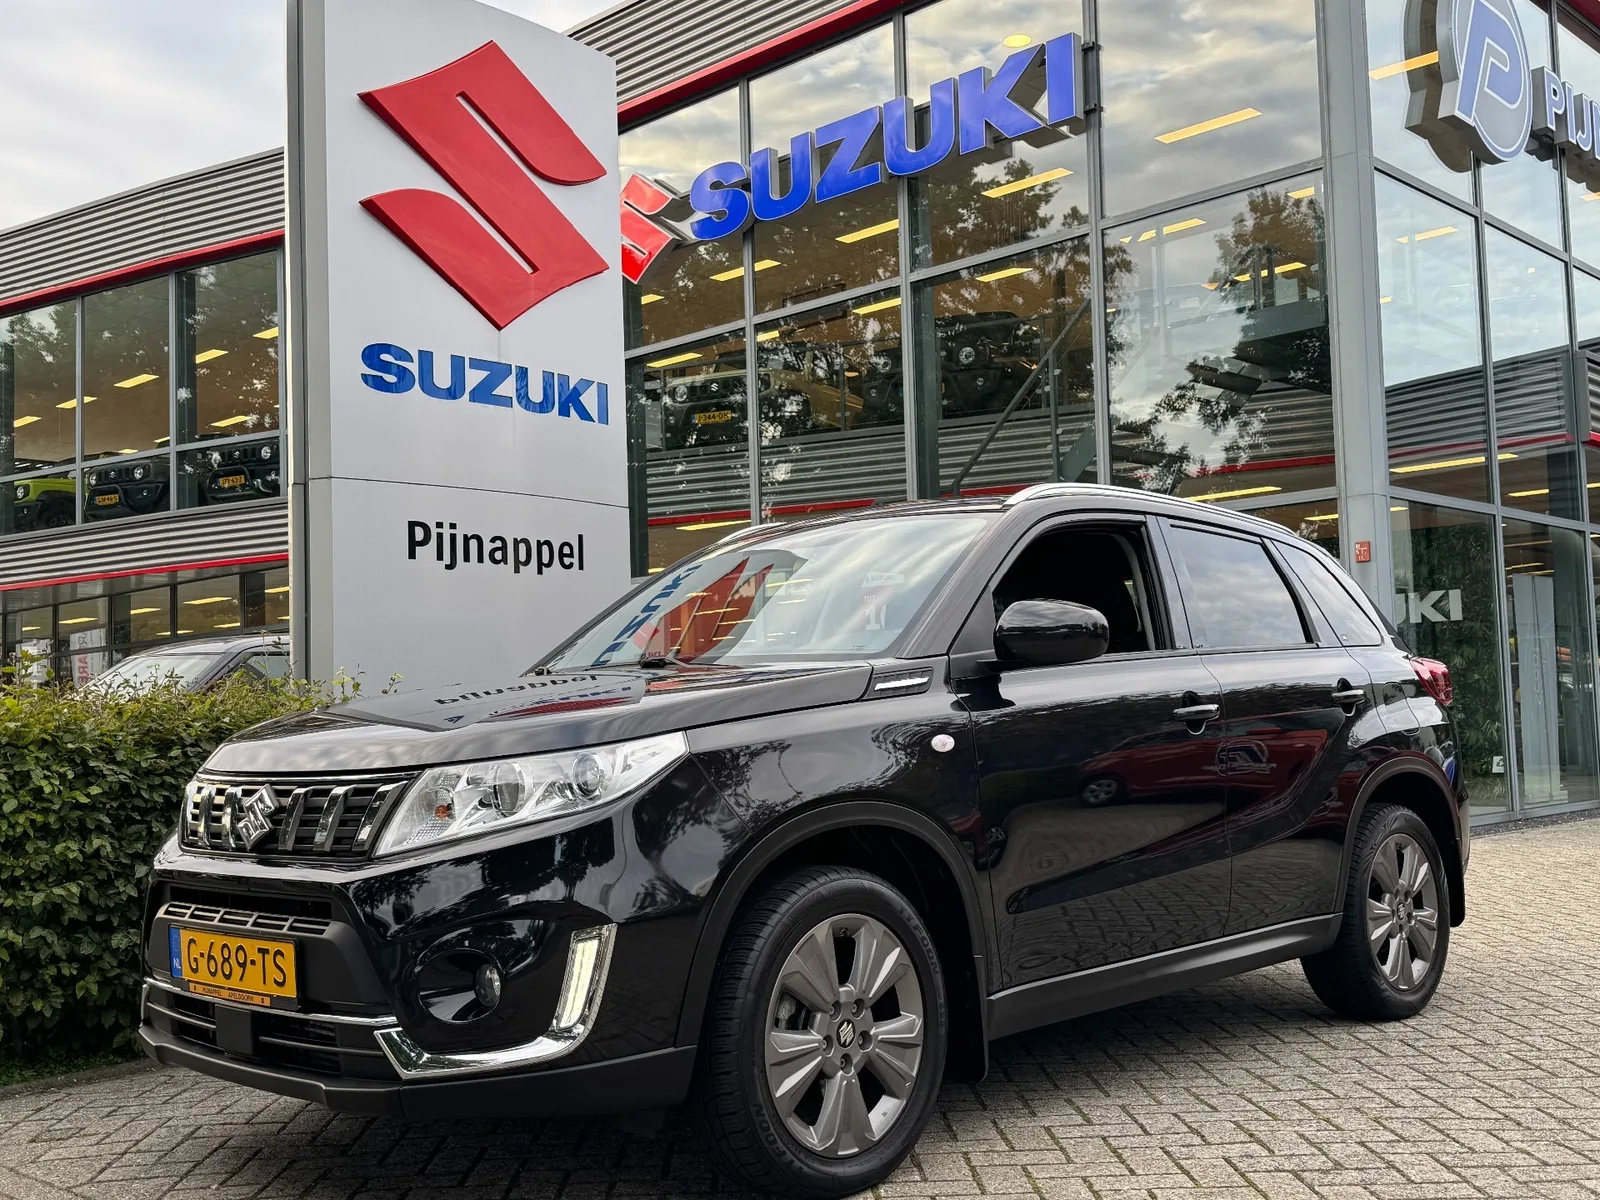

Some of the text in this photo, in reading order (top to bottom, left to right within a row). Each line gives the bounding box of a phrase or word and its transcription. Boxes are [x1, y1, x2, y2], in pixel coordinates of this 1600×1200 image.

[689, 32, 1081, 240] SUZUKI
[360, 342, 609, 425] SUZUKI
[407, 520, 584, 575] Pijnappel
[173, 957, 182, 969] NL
[187, 937, 287, 988] G-689-TS
[228, 991, 254, 1003] APELDOORN
